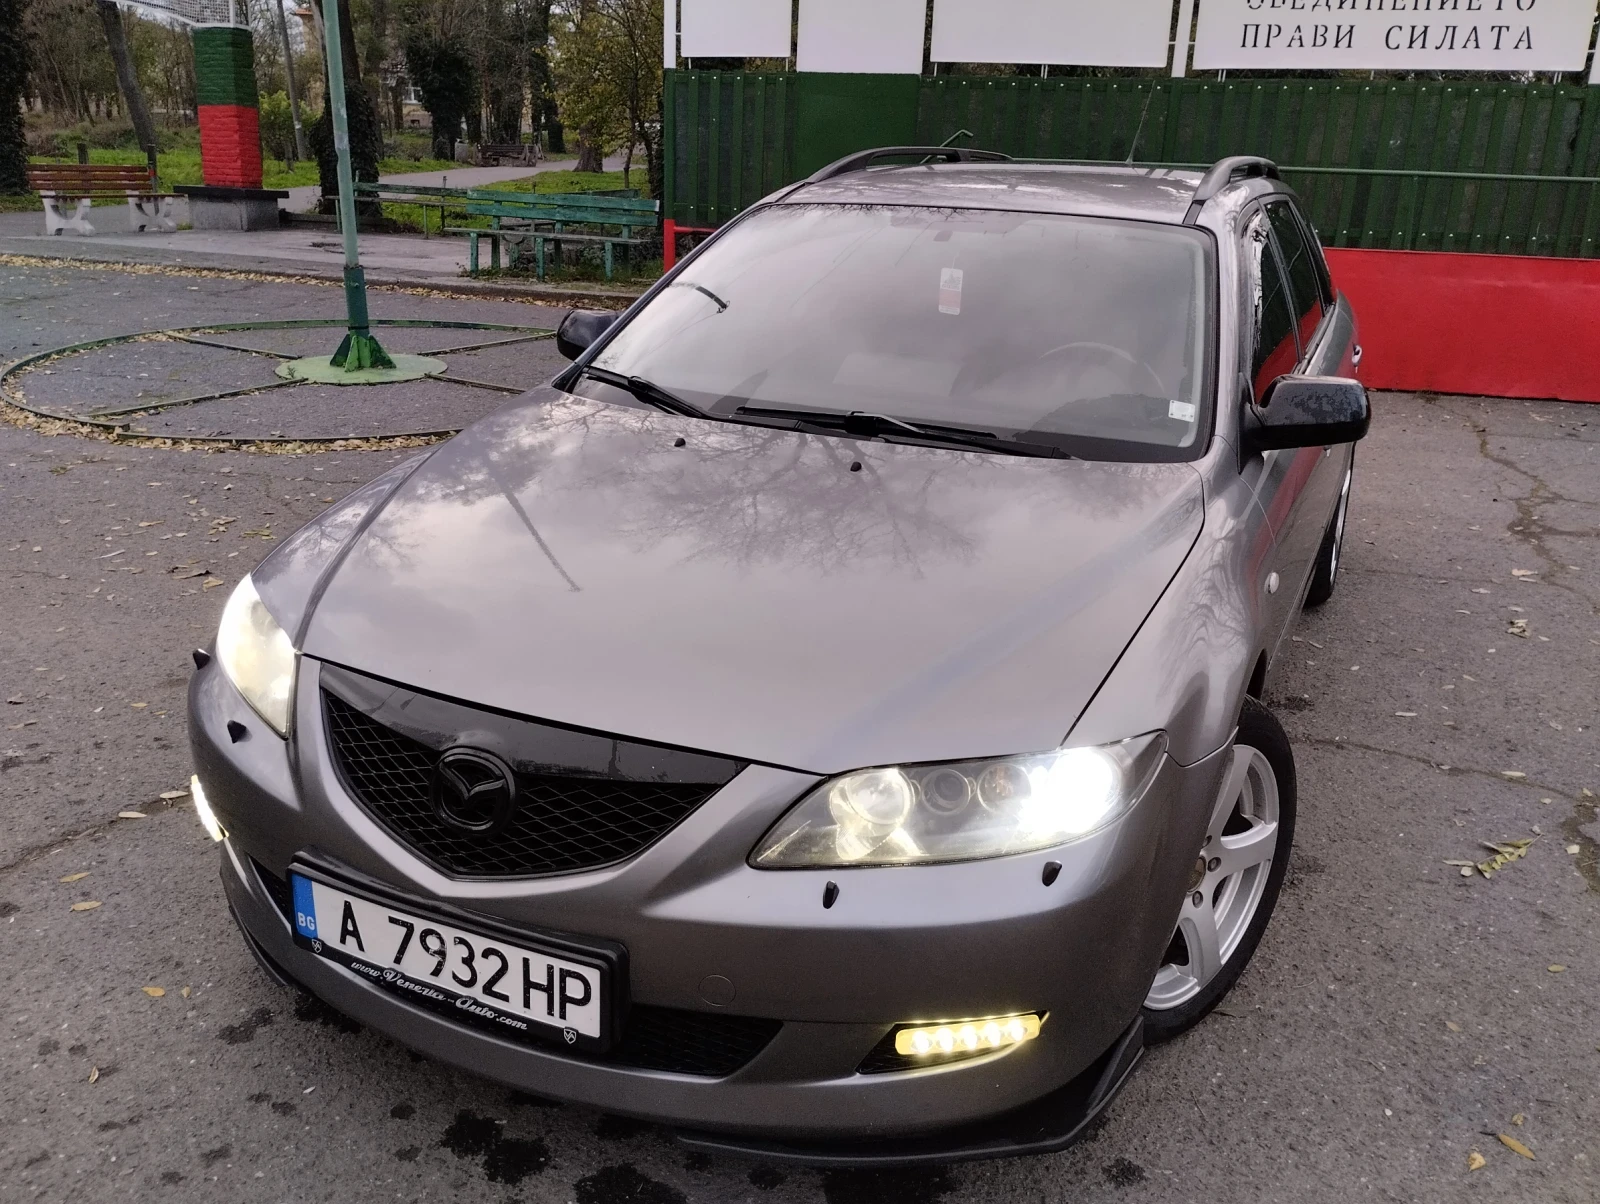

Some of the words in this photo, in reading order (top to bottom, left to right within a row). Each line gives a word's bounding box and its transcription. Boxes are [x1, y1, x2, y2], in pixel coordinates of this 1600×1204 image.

[1240, 23, 1356, 49] ПРАВИ
[1385, 24, 1533, 50] СИЛАТА
[297, 911, 316, 931] BG
[339, 899, 365, 953] A
[388, 915, 510, 1003] 7932
[522, 956, 592, 1021] HP
